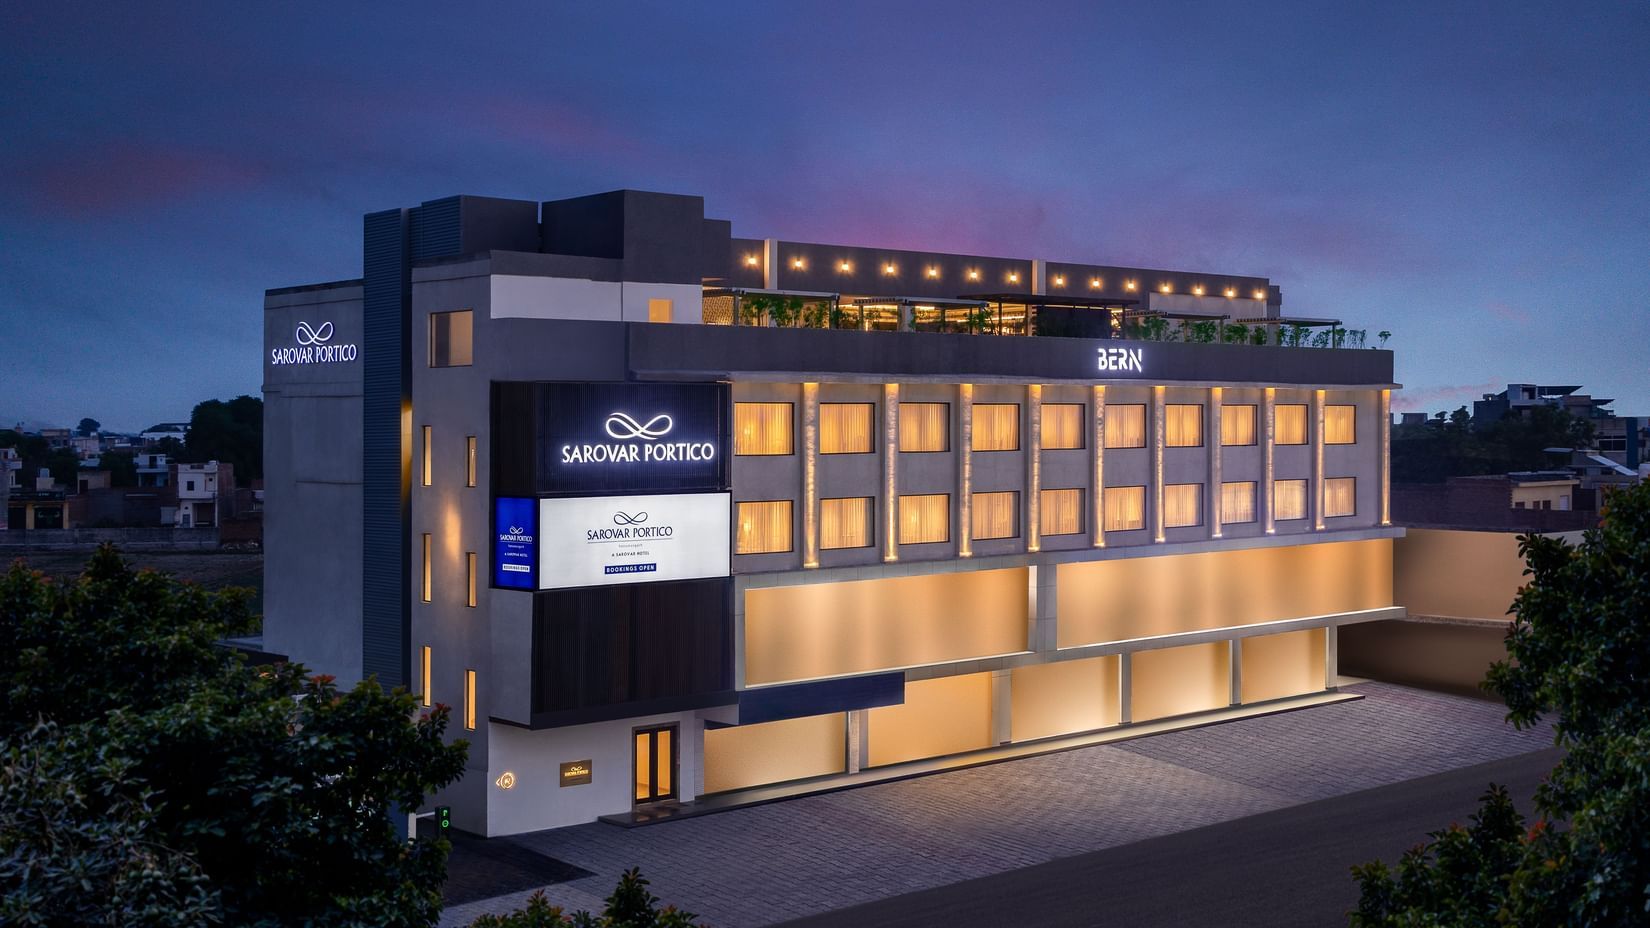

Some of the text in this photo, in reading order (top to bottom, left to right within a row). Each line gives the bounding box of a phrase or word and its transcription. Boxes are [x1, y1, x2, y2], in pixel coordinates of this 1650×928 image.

[272, 344, 357, 364] SAROVAR PORTICO
[1098, 348, 1142, 373] BERN
[562, 443, 714, 463] SAROVAR PORTICO
[587, 526, 673, 540] SAROVAR PORTICO
[606, 565, 637, 573] BOOKINGS
